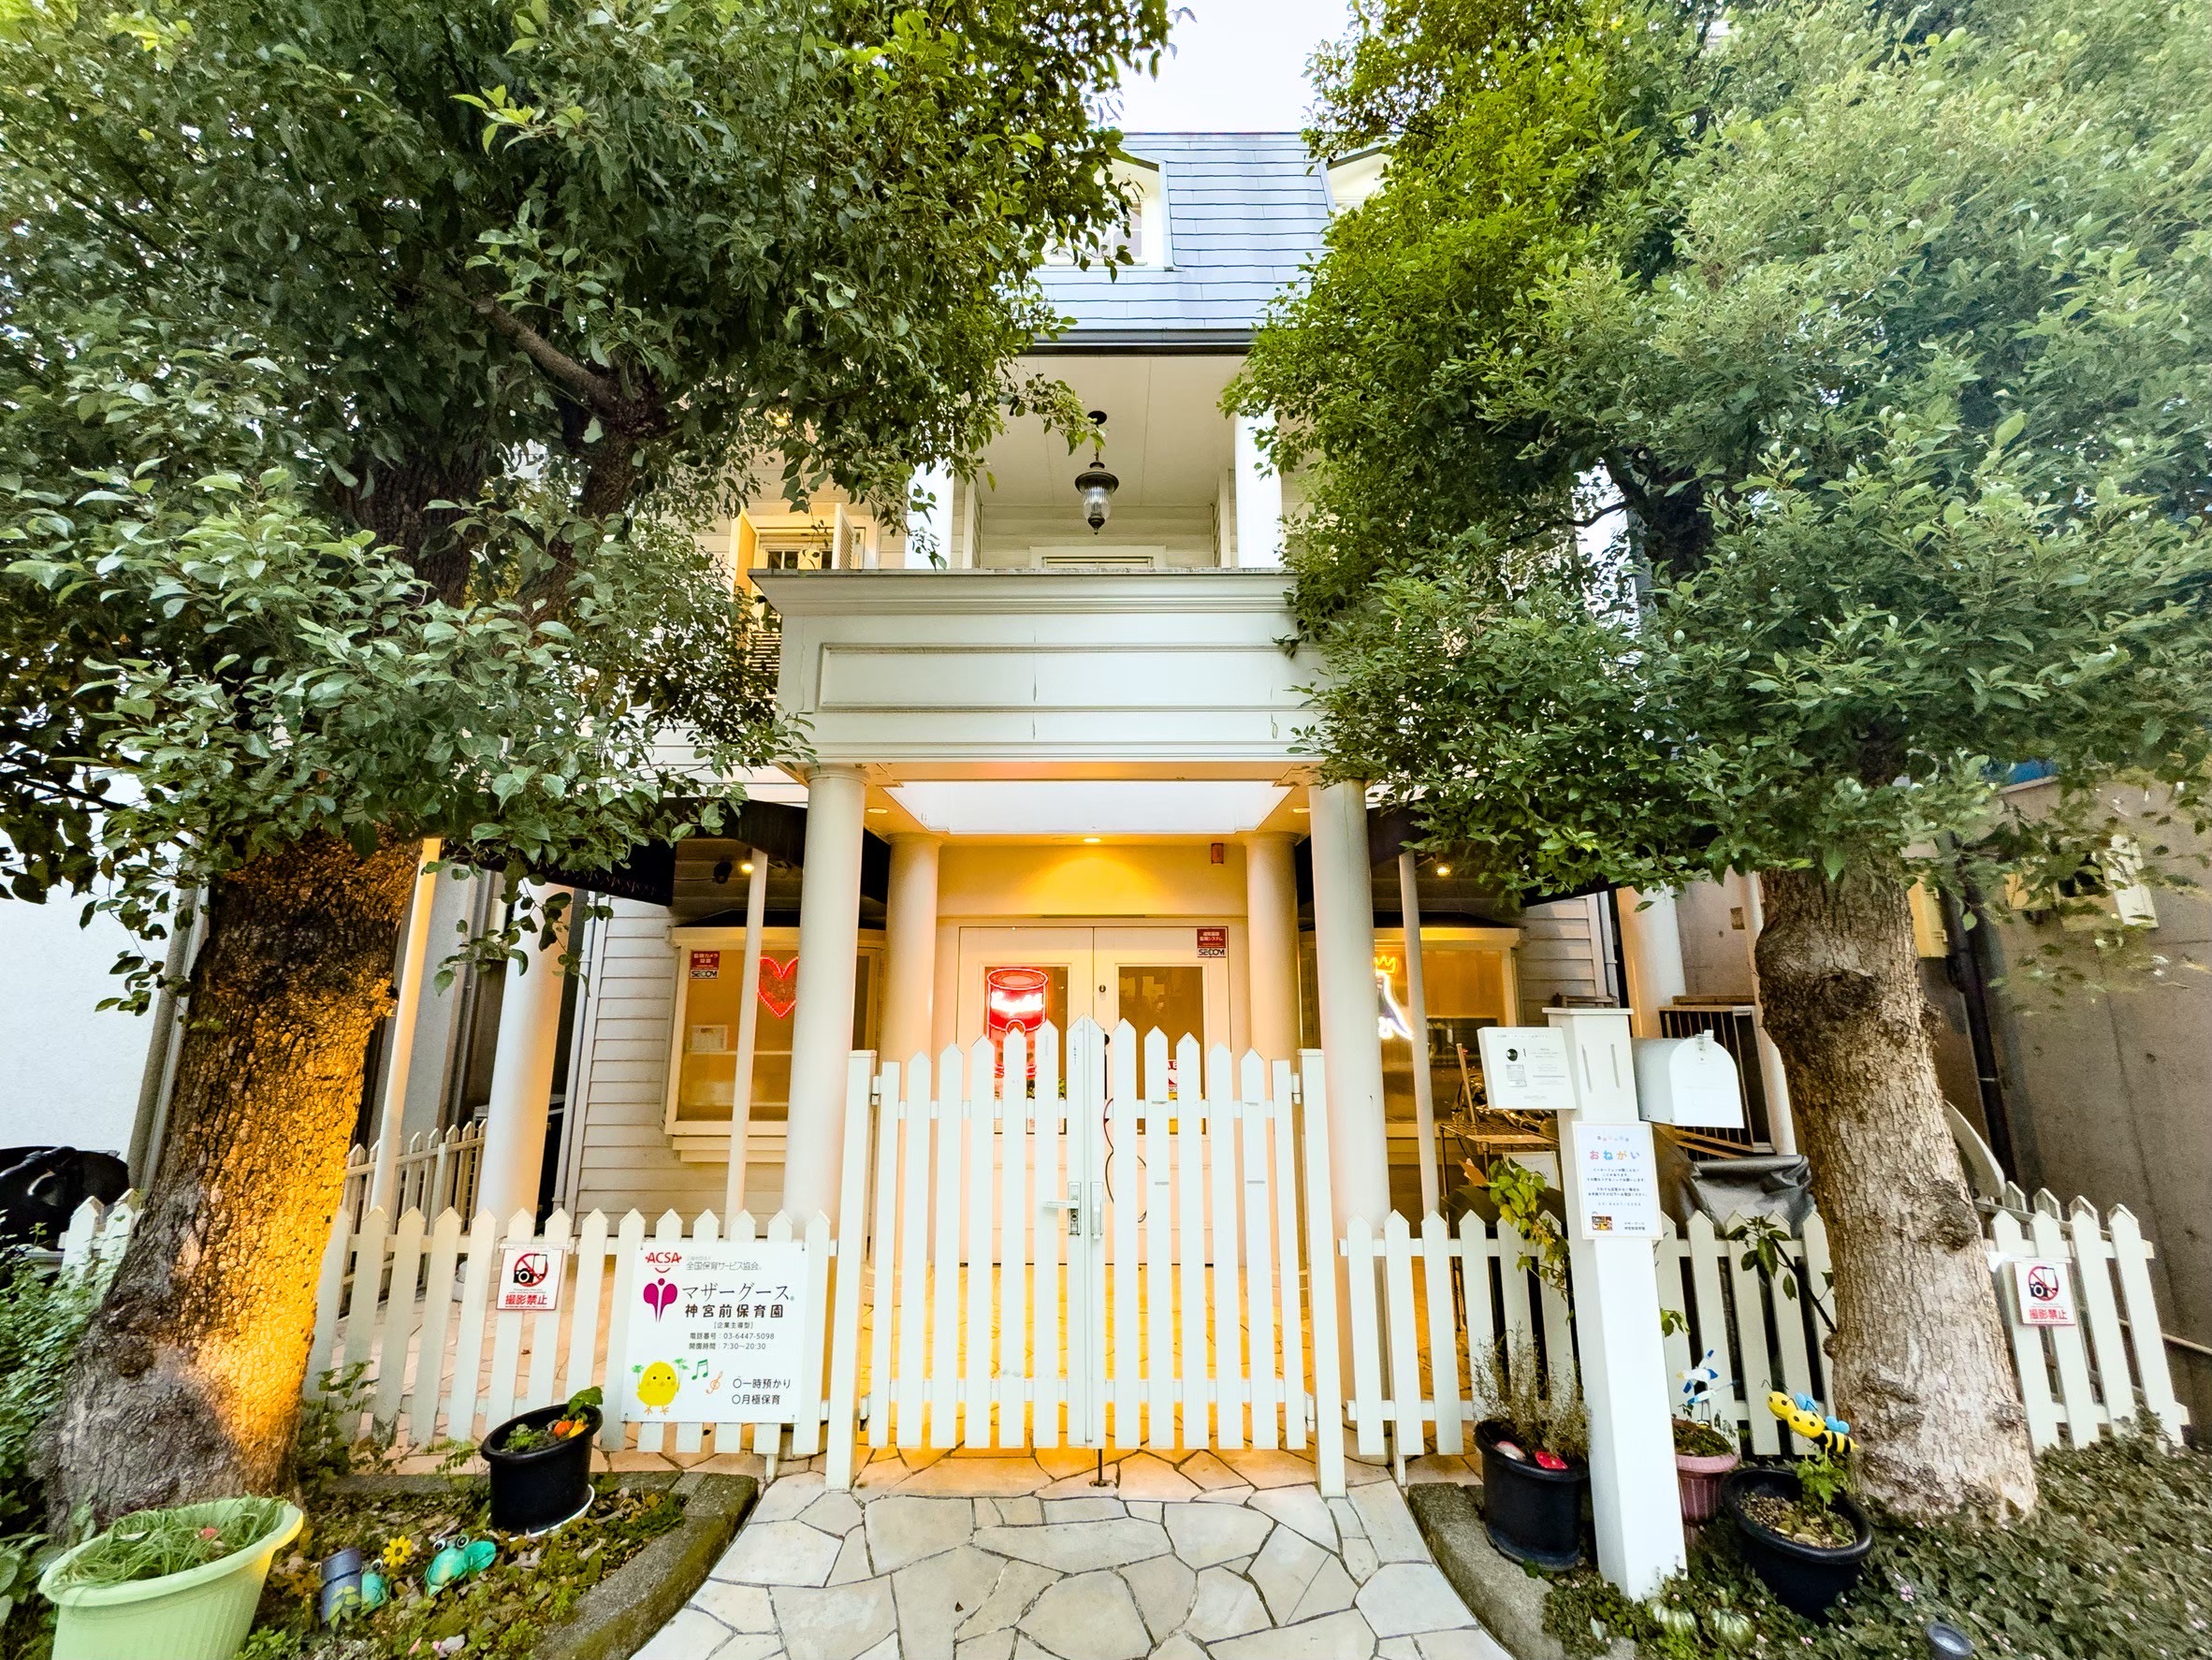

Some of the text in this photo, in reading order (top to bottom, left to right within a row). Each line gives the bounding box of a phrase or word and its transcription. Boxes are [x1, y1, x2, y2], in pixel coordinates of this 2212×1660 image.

[1590, 1150, 1639, 1160] おねがい
[646, 1252, 682, 1263] ACSA
[505, 1294, 547, 1304] 撮影禁止
[685, 1303, 783, 1318] 神宮前保育園
